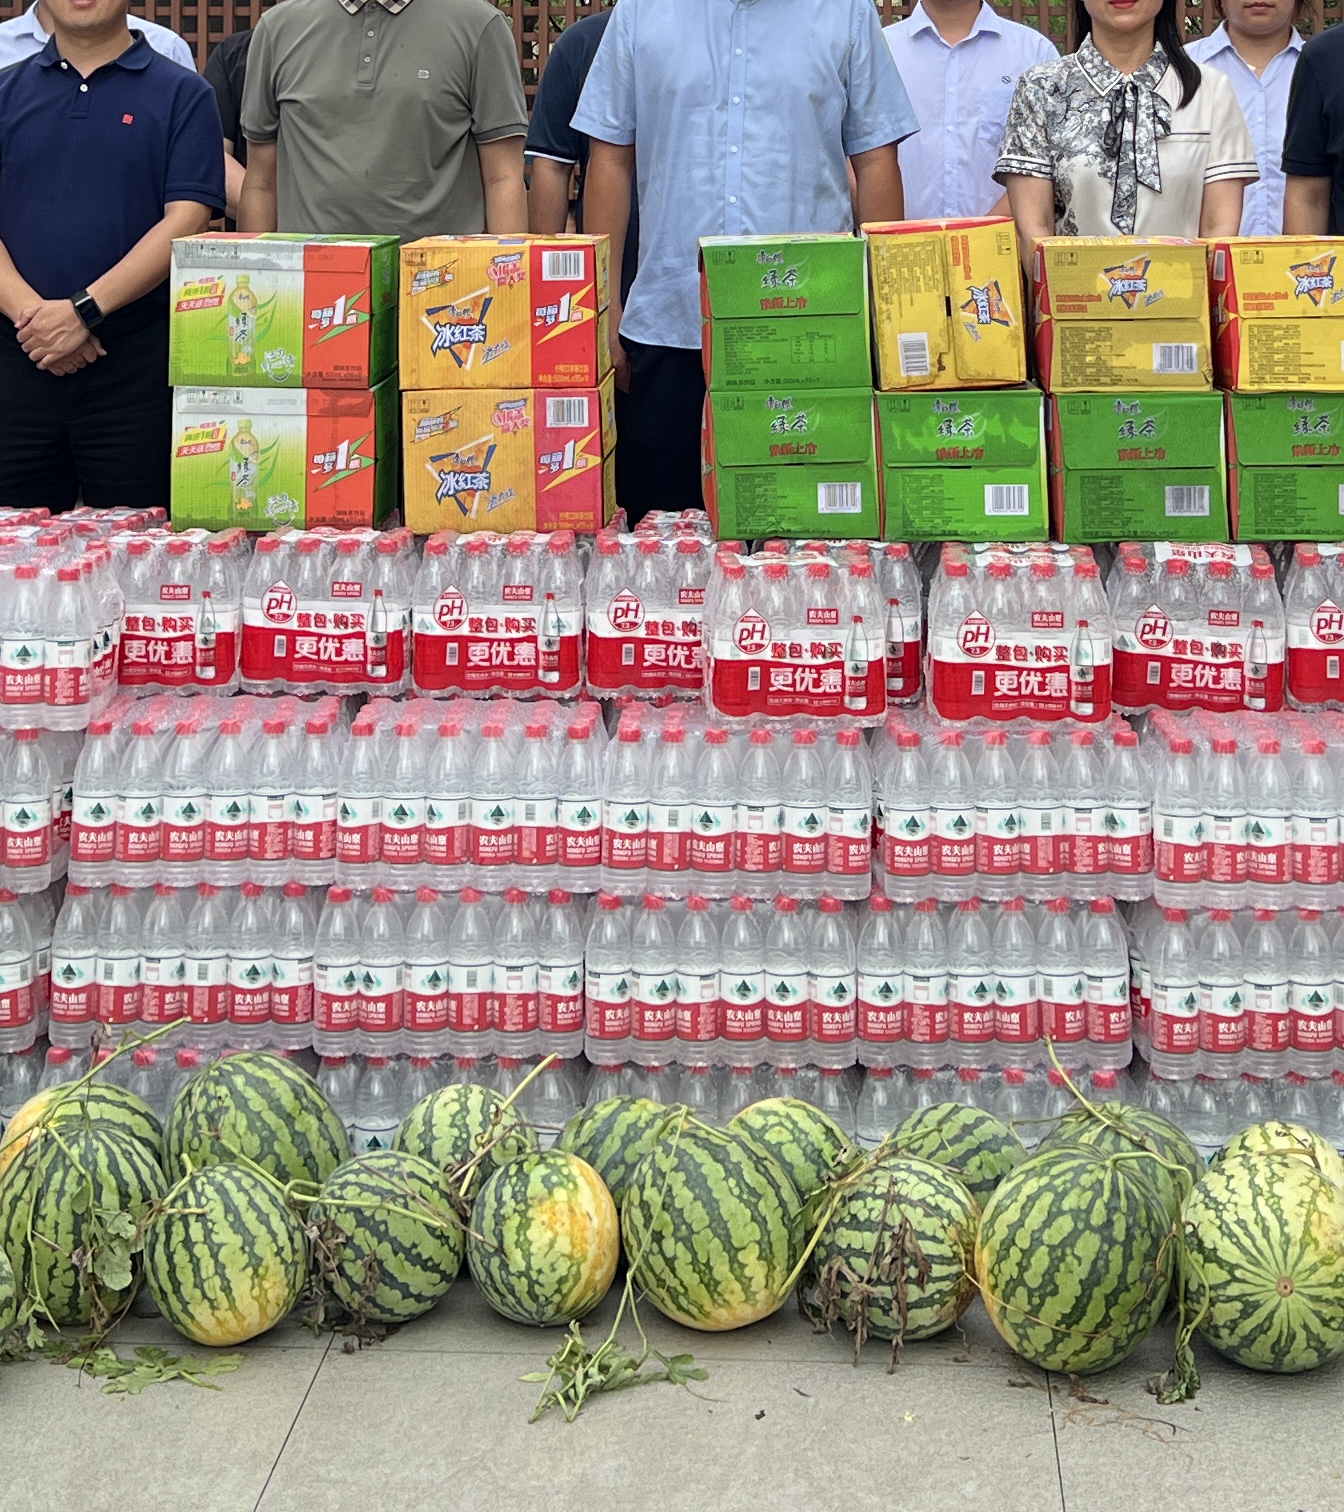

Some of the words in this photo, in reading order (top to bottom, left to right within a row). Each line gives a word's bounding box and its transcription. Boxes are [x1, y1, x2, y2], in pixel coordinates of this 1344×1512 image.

[761, 267, 798, 288] 绿茶
[433, 324, 487, 354] 冰红茶
[770, 412, 807, 435] 绿茶
[937, 416, 975, 438] 绿茶
[1118, 418, 1156, 439] 绿茶
[1293, 415, 1331, 436] 绿茶
[437, 471, 491, 501] 冰红茶
[267, 595, 292, 615] pH
[438, 599, 464, 620] pH
[613, 602, 640, 622] pH
[739, 624, 766, 644] pH
[1140, 620, 1168, 638] pH
[1316, 614, 1344, 634] pH
[963, 626, 990, 647] pH
[123, 640, 194, 664] 更优惠
[295, 637, 364, 661] 更优惠
[467, 642, 536, 666] 更优惠
[769, 667, 842, 693] 更优惠
[994, 671, 1068, 697] 更优惠
[1169, 663, 1242, 691] 更优惠
